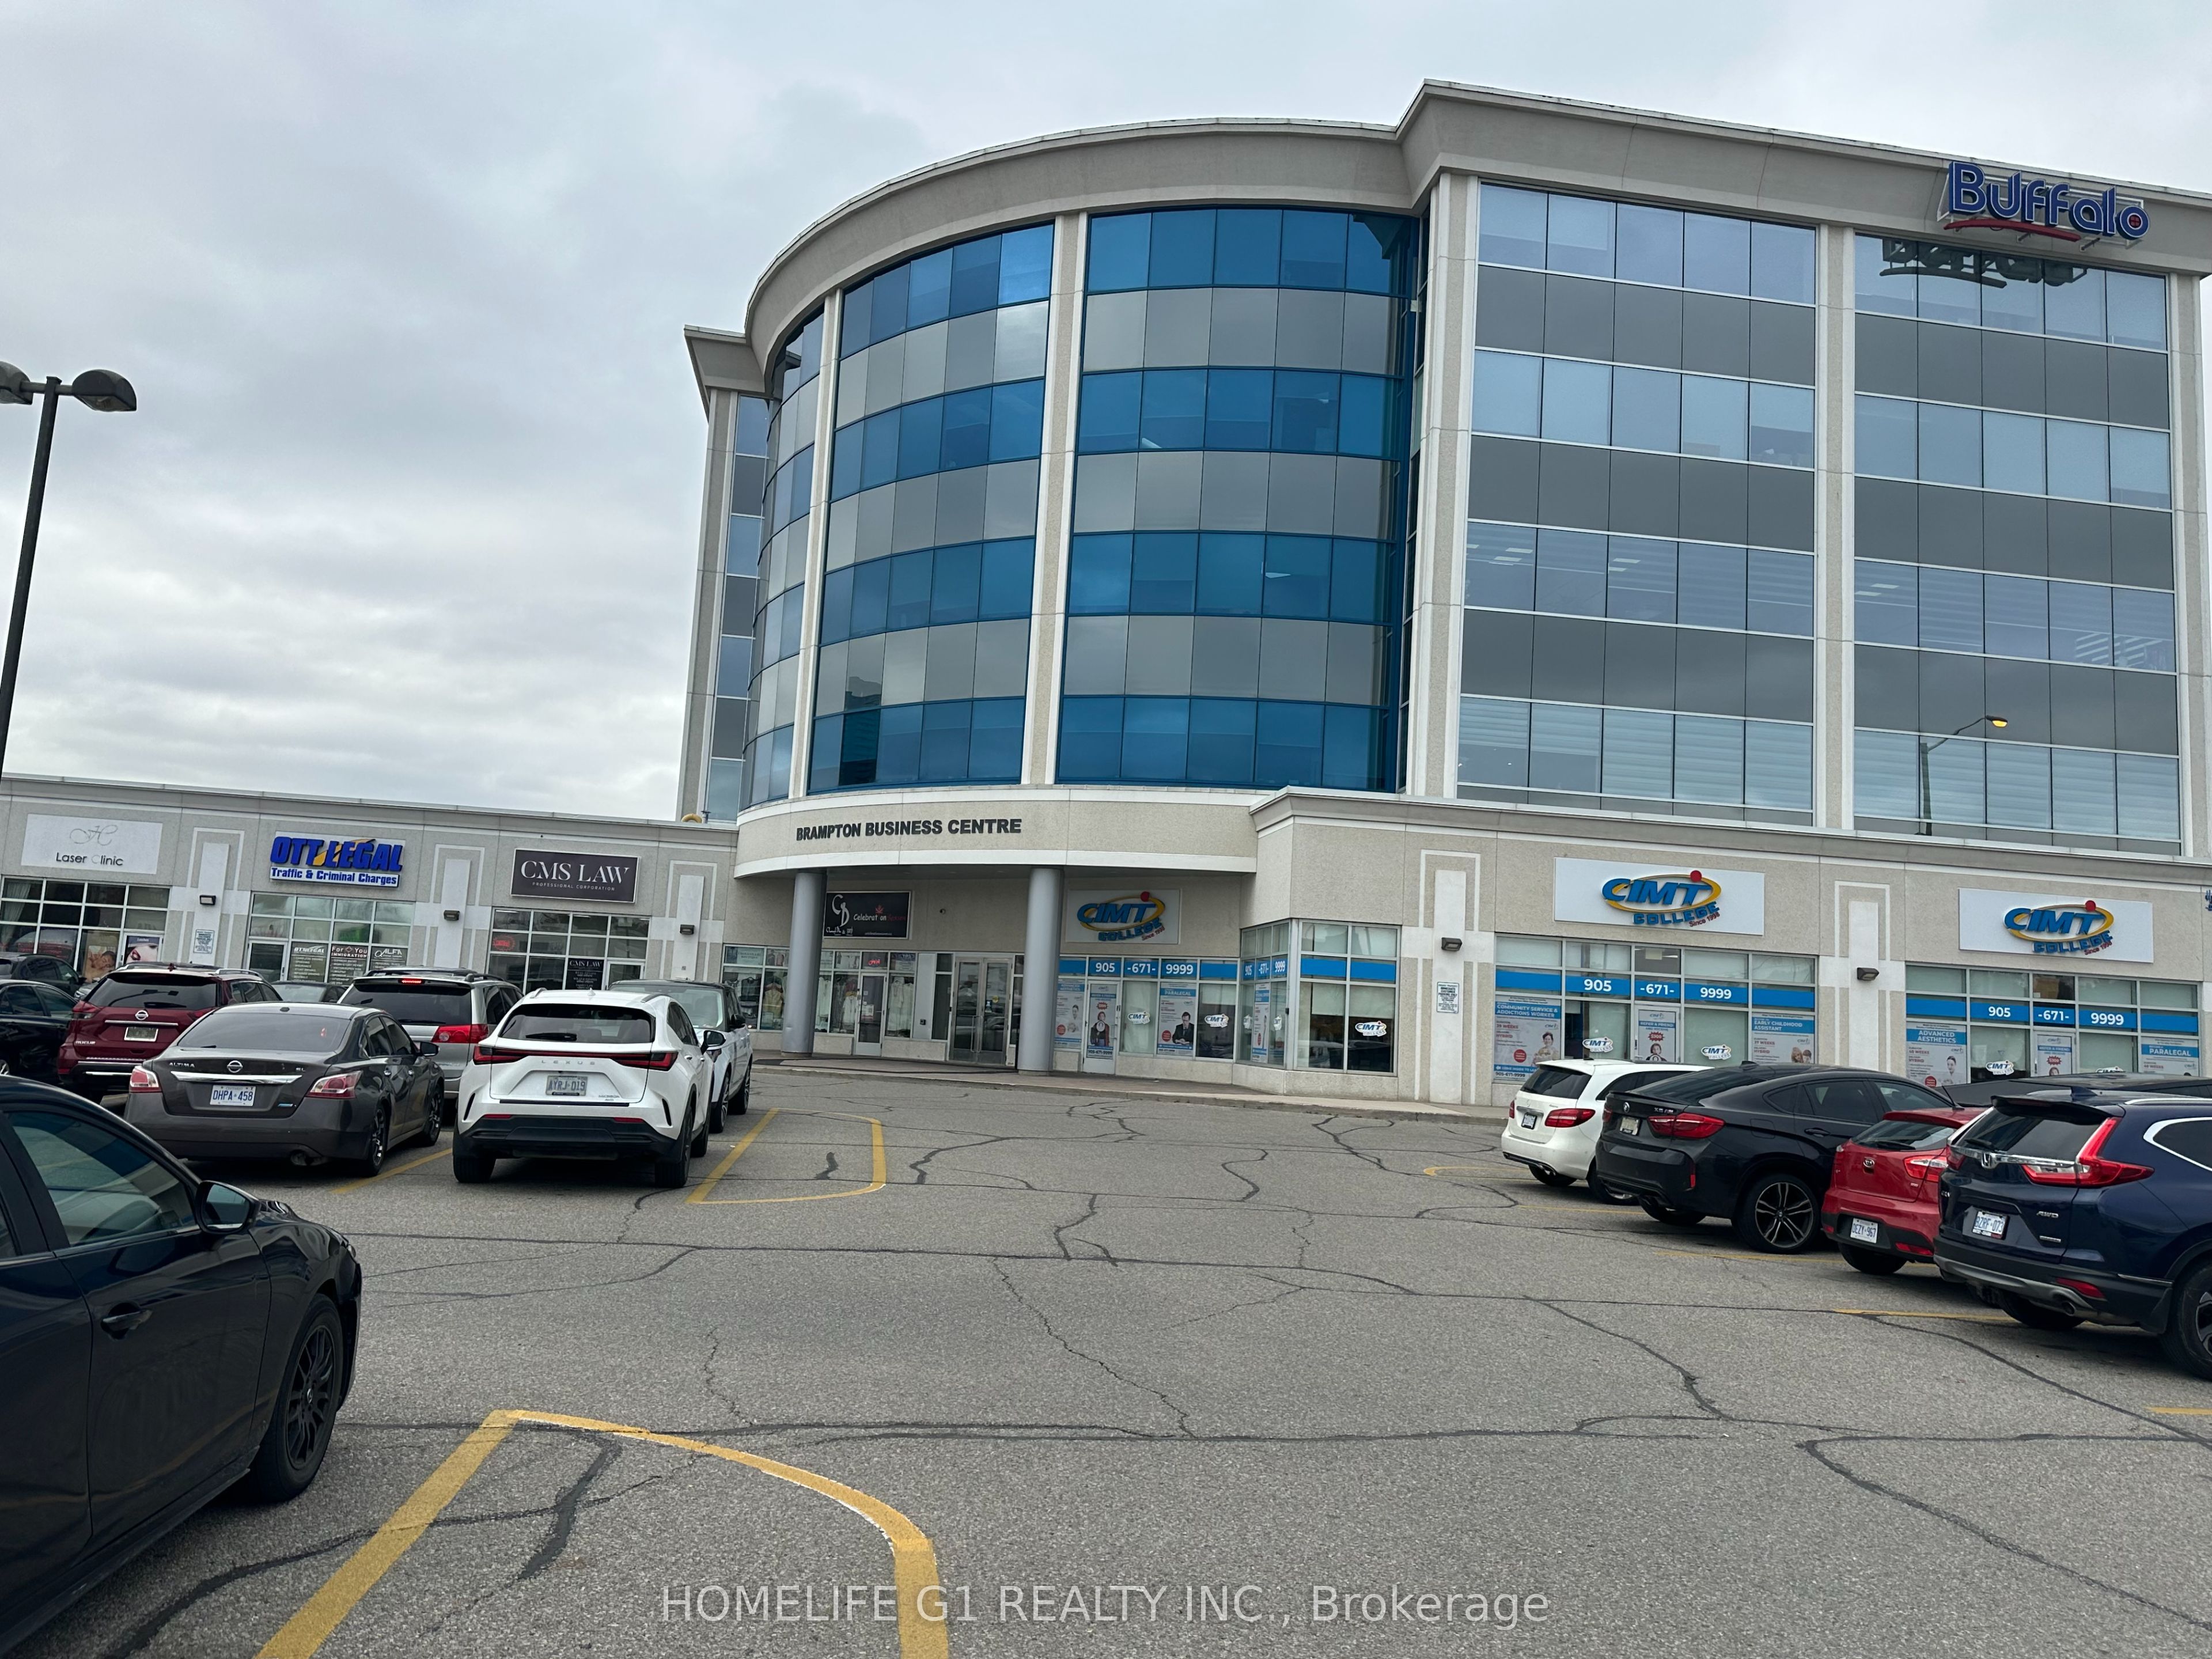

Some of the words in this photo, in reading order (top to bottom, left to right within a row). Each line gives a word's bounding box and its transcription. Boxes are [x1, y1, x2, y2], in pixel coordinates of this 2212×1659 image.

[1948, 161, 2150, 241] Buffalo
[796, 823, 861, 841] BRAMPTON
[865, 820, 942, 836] BUSINESS
[948, 819, 1022, 834] CENTRE
[56, 853, 87, 863] Laser
[92, 854, 124, 866] Clinic
[270, 836, 324, 866] OTT
[324, 840, 403, 872] LEGAL
[271, 868, 302, 878] Traffic
[306, 870, 313, 879] &
[316, 870, 355, 882] Criminal
[358, 873, 397, 885] Charges
[521, 860, 571, 881] CMS
[578, 864, 630, 884] LAW
[1602, 878, 1712, 906] CIMT
[854, 913, 887, 921] Celebraton
[1077, 903, 1157, 923] CIMT
[1633, 902, 1720, 925] COLLEGE
[1689, 918, 1706, 927] Since
[1707, 912, 1720, 922] 1998
[2005, 907, 2106, 935] CIMT
[1098, 917, 1162, 942] COLLEGE
[2033, 930, 2113, 953] COLLEGE
[2084, 947, 2100, 955] Since
[1096, 963, 1115, 973] 905
[1127, 963, 1156, 974] -671-
[1166, 964, 1194, 975] 9999
[1275, 961, 1285, 972] 9999
[1584, 979, 1612, 992] 905
[1640, 983, 1675, 995] -671-
[1700, 987, 1732, 999] 9999
[1988, 1006, 2011, 1017] 905
[2038, 1010, 2069, 1021] -671-
[2090, 1013, 2124, 1025] 9999
[2149, 1048, 2191, 1056] PARALEGAL
[213, 1090, 233, 1100] DHPA
[238, 1091, 253, 1101] 458
[1852, 1223, 1865, 1235] DEZY
[1866, 1226, 1876, 1237] 967
